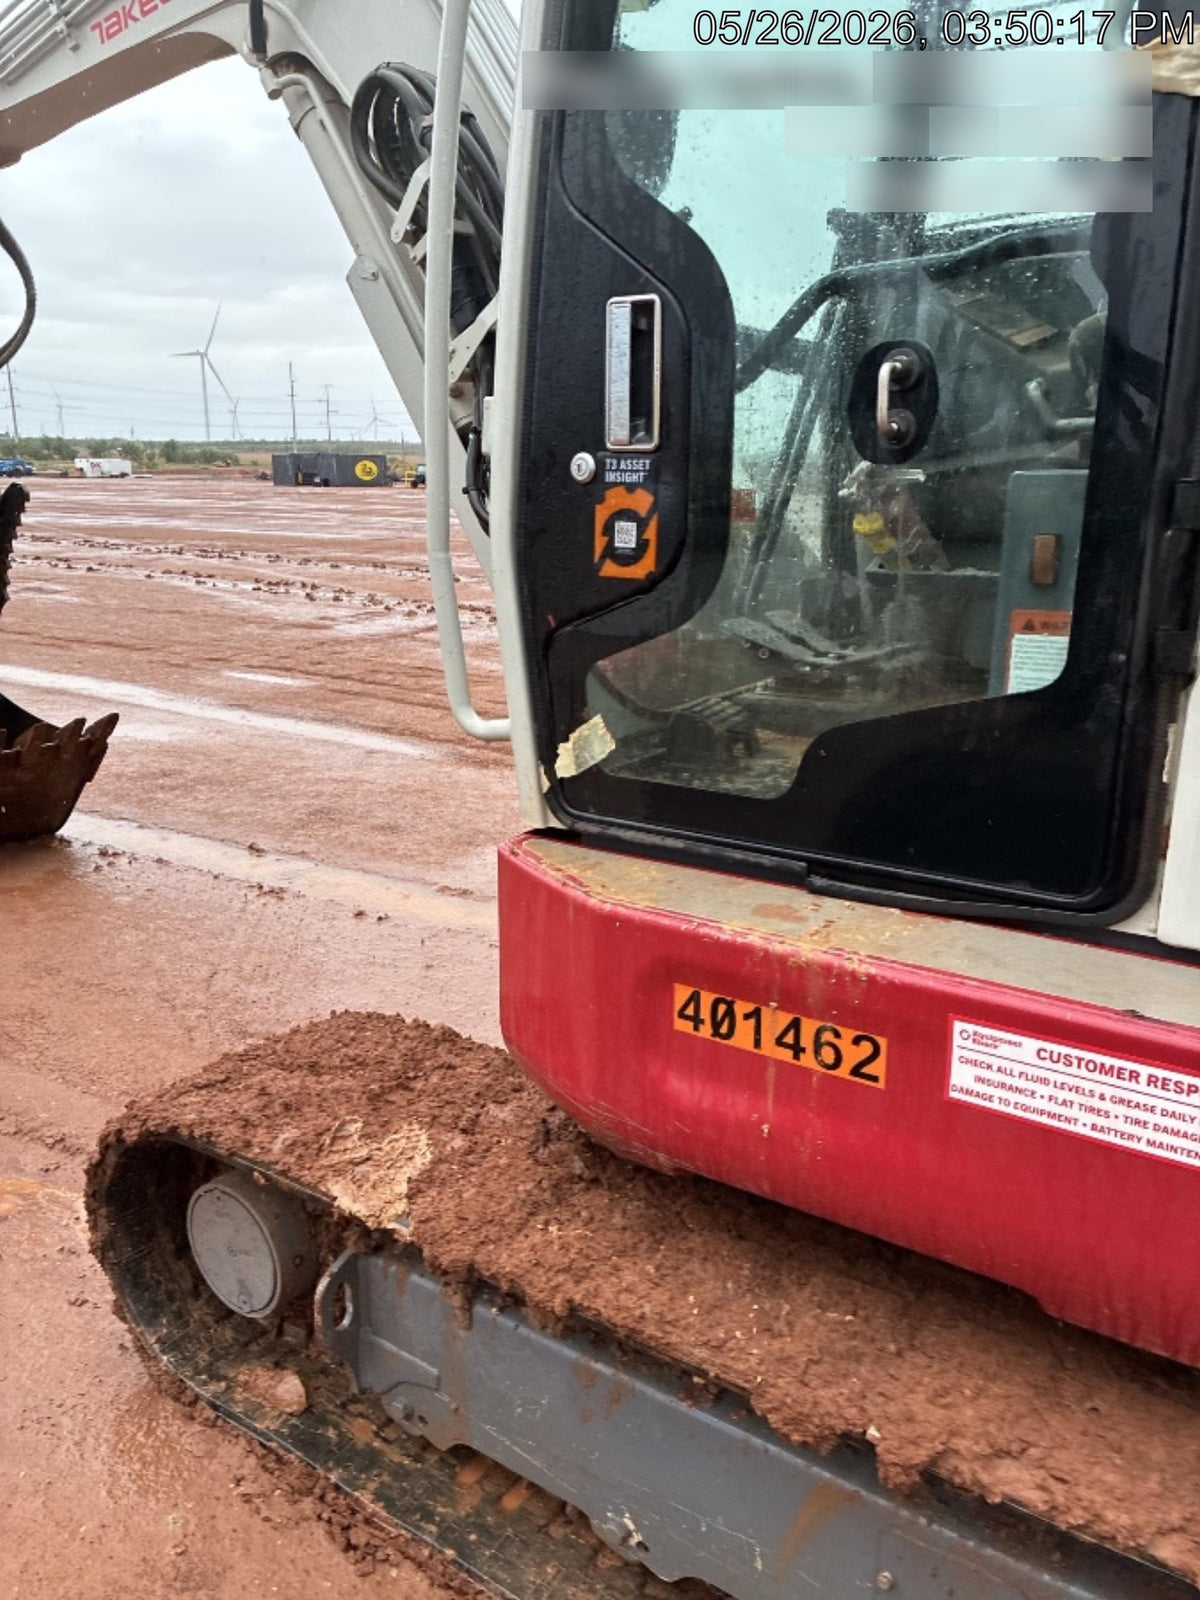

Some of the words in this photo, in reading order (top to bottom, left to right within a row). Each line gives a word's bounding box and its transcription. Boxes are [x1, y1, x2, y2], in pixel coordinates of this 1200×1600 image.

[90, 0, 171, 44] TAKE
[604, 471, 644, 483] INSIGHT
[620, 458, 651, 470] ASSET
[677, 989, 882, 1083] 401462
[958, 1055, 994, 1073] CHECK
[996, 1065, 1016, 1079] ALL
[1018, 1071, 1051, 1087] FLUID
[1053, 1080, 1096, 1099] LEVELS
[1098, 1092, 1107, 1102] &
[1109, 1095, 1157, 1116] GREASE
[1160, 1107, 1197, 1124] DAILY
[1036, 1046, 1141, 1085] CUSTOMER
[1146, 1073, 1200, 1097] RESP
[951, 1084, 995, 1103] DAMAGE
[997, 1096, 1011, 1107] TO
[1013, 1101, 1079, 1126] EQUIPMENT
[1090, 1122, 1142, 1144] BATTERY
[974, 1074, 1037, 1099] INSURANCE
[1047, 1094, 1075, 1109] FLAT
[1077, 1102, 1110, 1119] TIRES
[1123, 1114, 1150, 1130] TIRE
[1152, 1123, 1200, 1144] DAMAG
